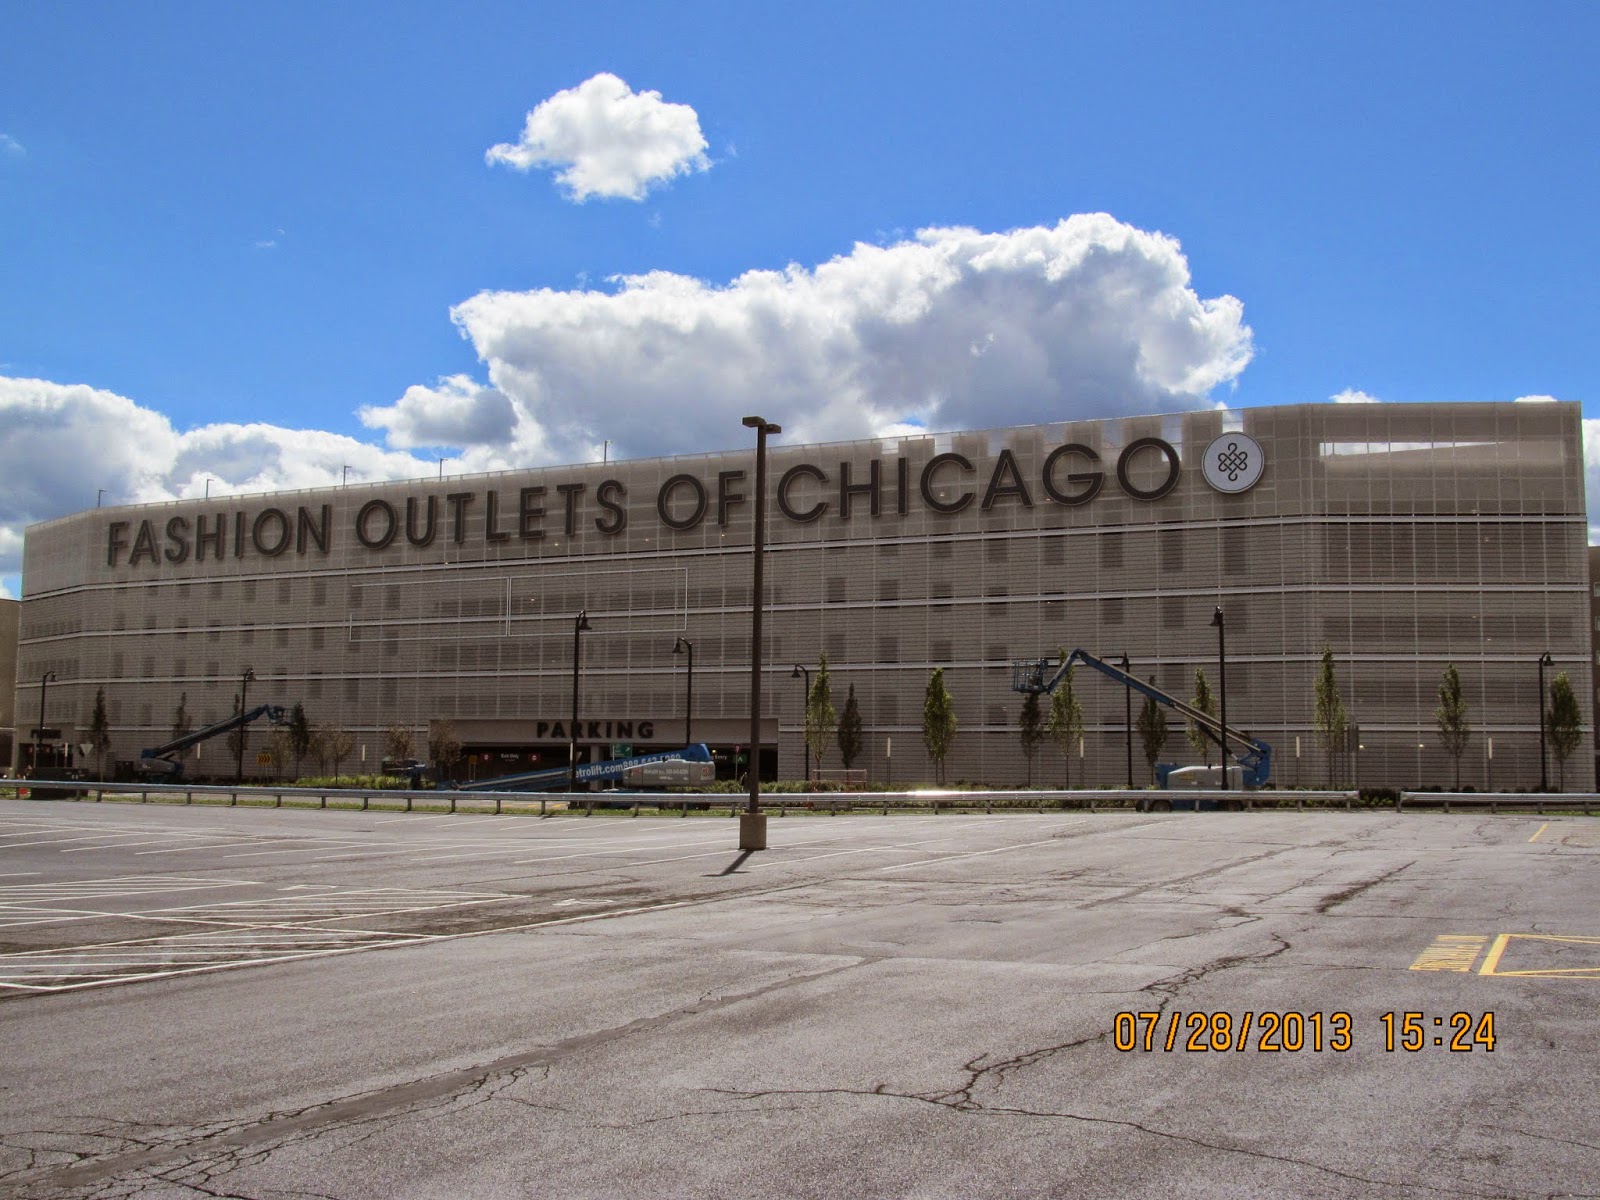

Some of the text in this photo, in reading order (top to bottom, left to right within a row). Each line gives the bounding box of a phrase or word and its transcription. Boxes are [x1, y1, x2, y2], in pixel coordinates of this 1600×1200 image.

[107, 437, 1183, 568] FASHION OUTLETS OF CHICAGO
[536, 721, 654, 739] PARKING
[575, 764, 624, 778] etrolift.com
